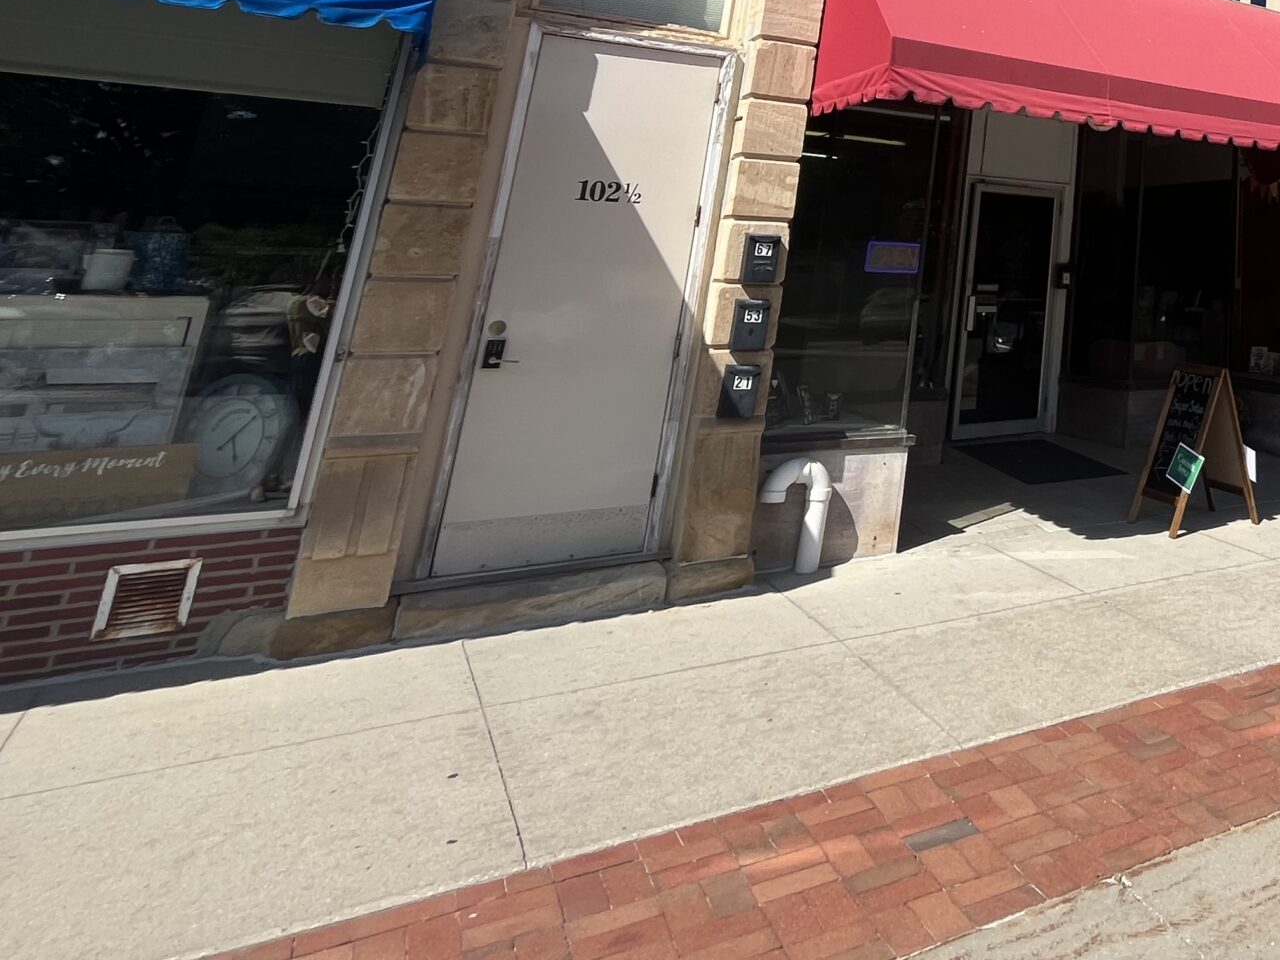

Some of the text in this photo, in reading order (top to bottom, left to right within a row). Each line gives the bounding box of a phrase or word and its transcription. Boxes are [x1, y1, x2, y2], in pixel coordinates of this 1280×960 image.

[756, 243, 772, 256] 67
[745, 309, 761, 322] 53
[734, 376, 751, 389] 21
[13, 458, 77, 479] Every
[81, 450, 167, 476] Moment
